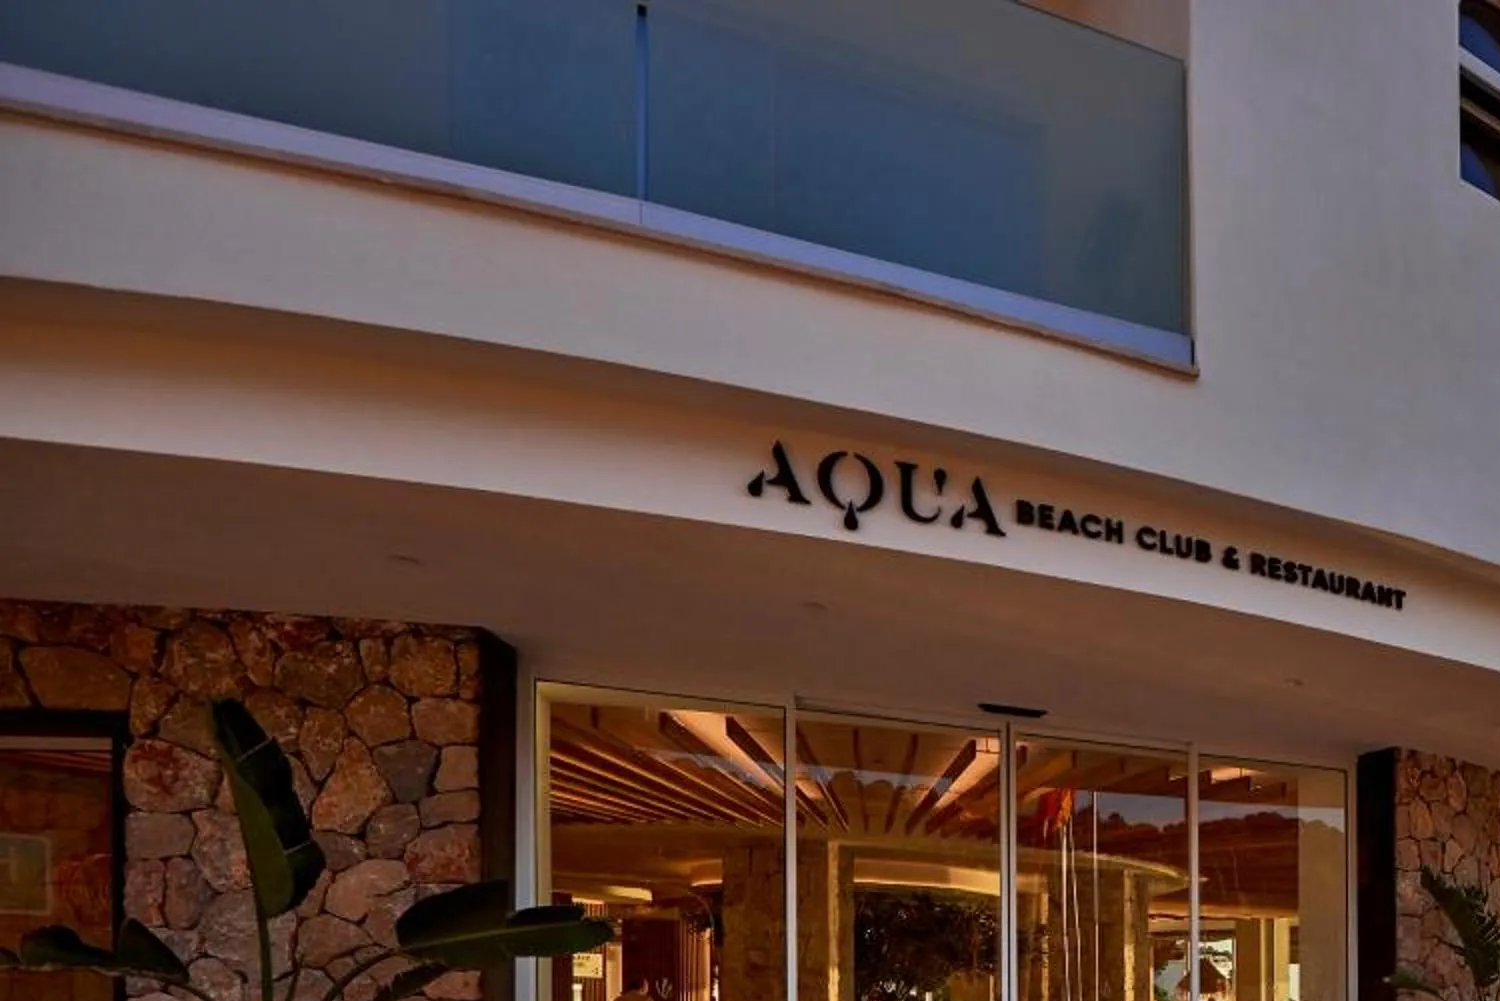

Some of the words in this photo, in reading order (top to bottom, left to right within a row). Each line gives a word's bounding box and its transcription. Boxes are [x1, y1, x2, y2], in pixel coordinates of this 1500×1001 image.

[747, 439, 1006, 537] AQUA
[1015, 499, 1124, 544] BEACH
[1135, 525, 1212, 564] CLUB
[1221, 546, 1240, 571] &
[1249, 551, 1406, 610] RESTAURANT
